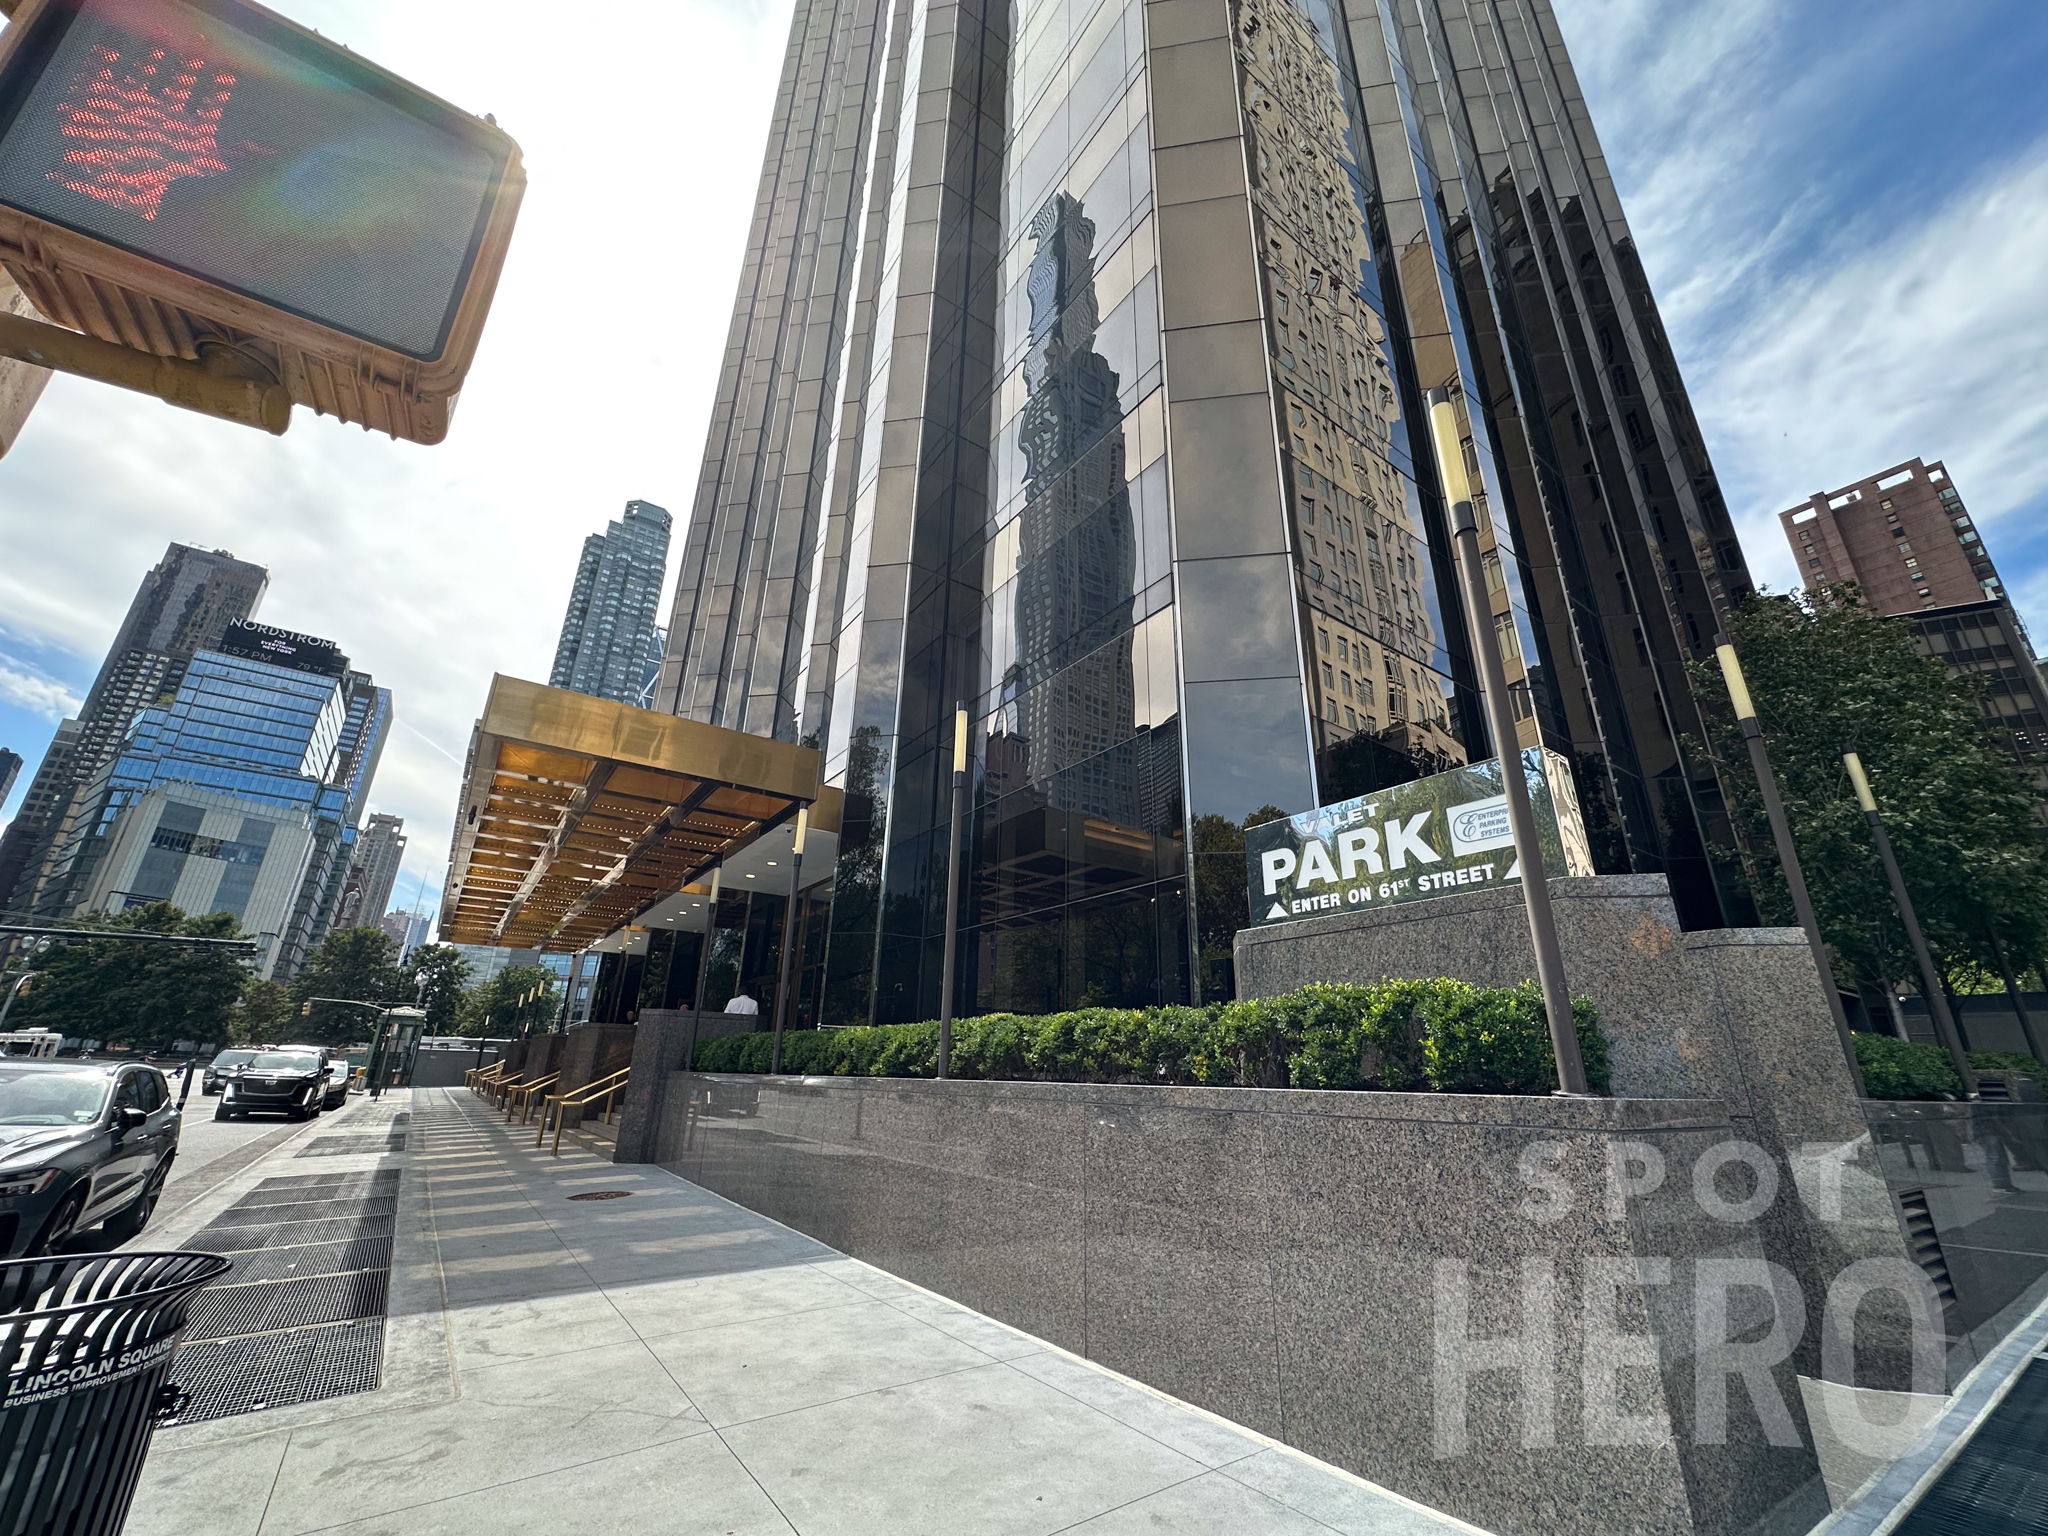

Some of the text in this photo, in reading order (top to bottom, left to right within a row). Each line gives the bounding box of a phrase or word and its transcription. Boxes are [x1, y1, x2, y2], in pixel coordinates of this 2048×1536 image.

[229, 616, 335, 650] NORDSTROM
[222, 644, 272, 662] 1:57 PM
[260, 640, 297, 652] EVERYTHING
[276, 647, 292, 655] YORK
[297, 662, 310, 671] 79
[1300, 802, 1379, 834] VALET
[1478, 808, 1509, 821] ENTERPRI
[1480, 817, 1507, 829] PARKING
[1481, 826, 1510, 838] SYSTEMS
[1261, 810, 1442, 896] PARK
[1291, 863, 1495, 915] ENTER ON 61ST STREET
[7, 1334, 176, 1397] LINCOLN SQUARE
[2, 1350, 171, 1408] BUSINESS IMPROVEMENT DISTRICT
